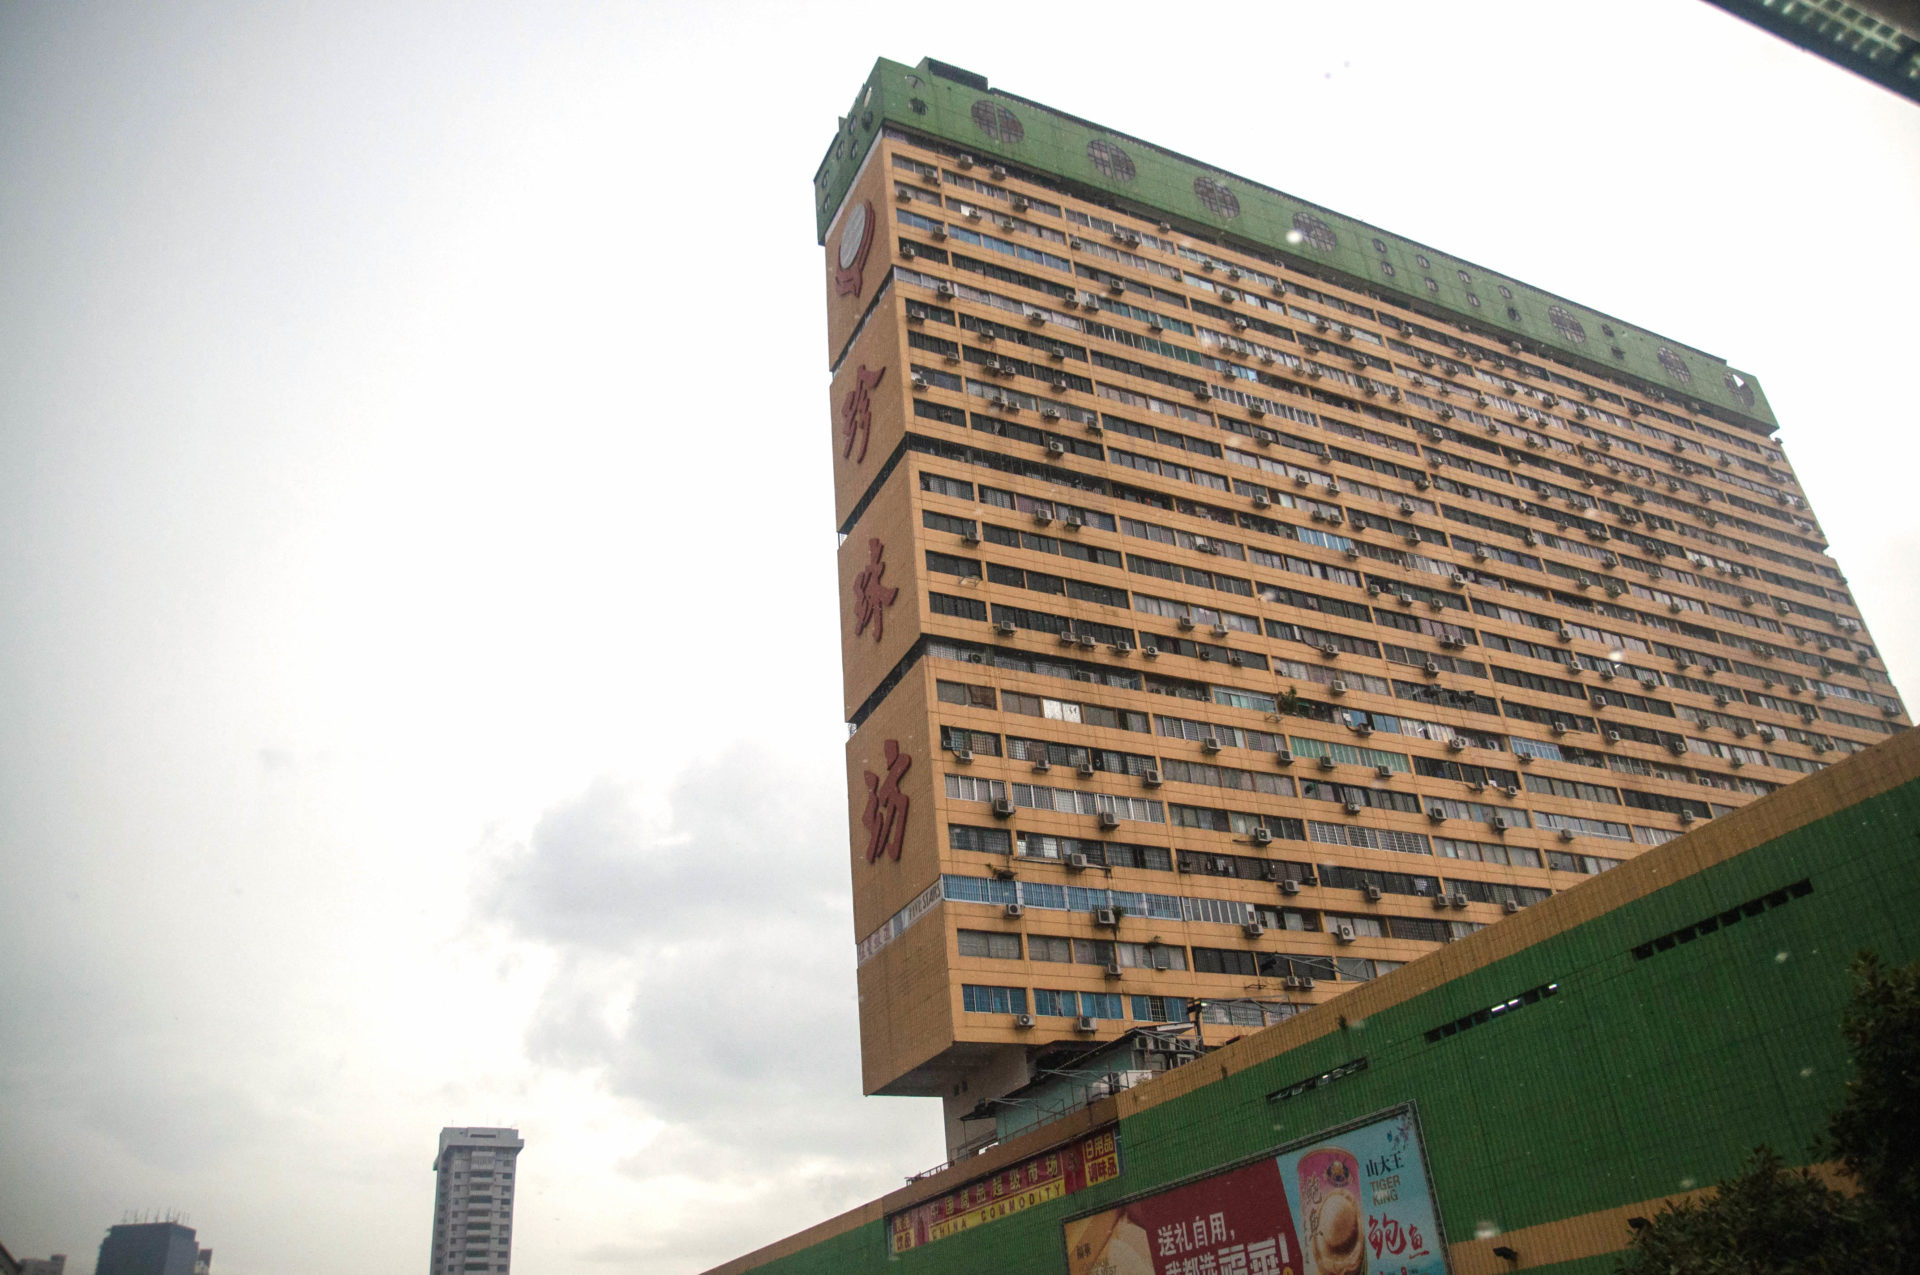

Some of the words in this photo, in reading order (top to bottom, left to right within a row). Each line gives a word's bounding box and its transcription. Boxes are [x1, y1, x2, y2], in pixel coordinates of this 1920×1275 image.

[1086, 1132, 1113, 1160] 日用品
[1366, 1151, 1404, 1177] 山大王
[1370, 1175, 1401, 1192] TIGER
[1372, 1189, 1399, 1206] KING
[932, 1218, 967, 1240] CHINA
[980, 1183, 1061, 1222] COMMODITY
